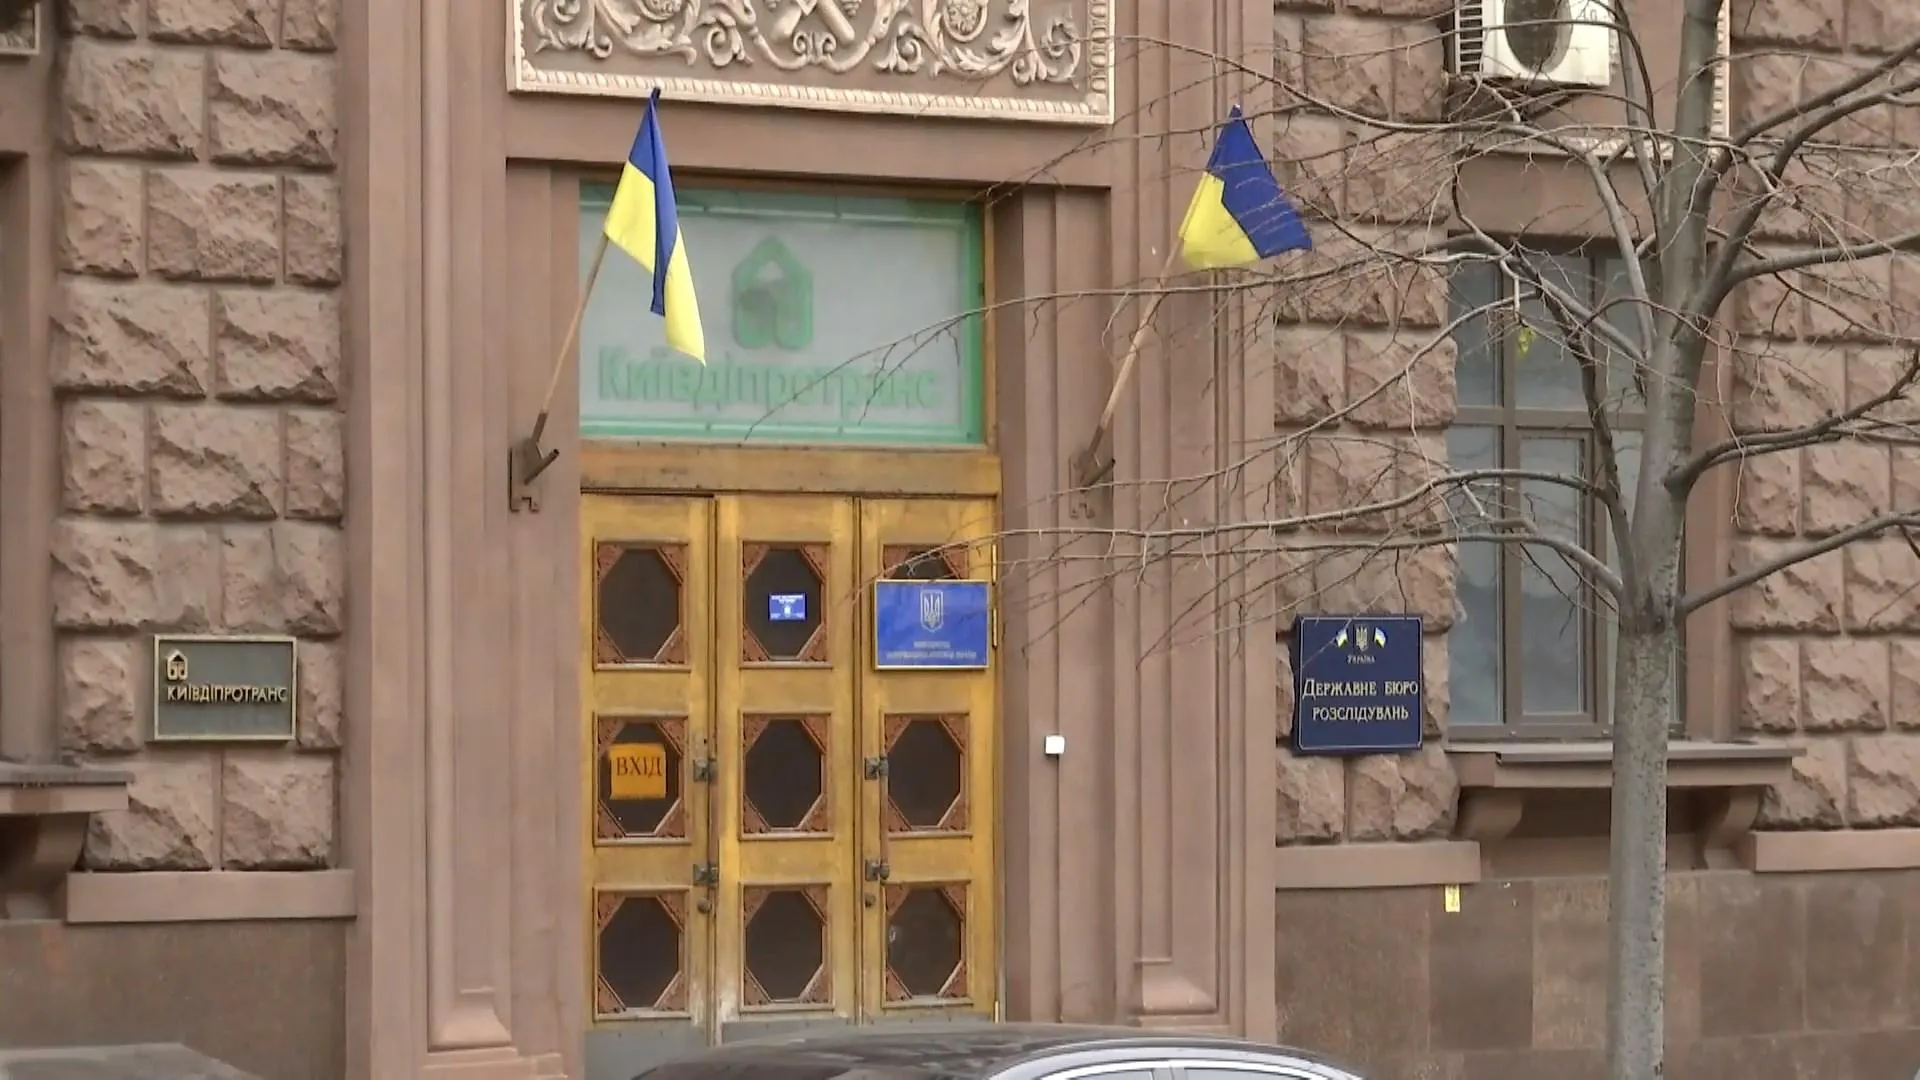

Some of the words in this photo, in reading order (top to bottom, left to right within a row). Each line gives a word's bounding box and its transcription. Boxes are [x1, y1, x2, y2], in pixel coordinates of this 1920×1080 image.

[598, 345, 941, 412] Київдіпротранс
[166, 683, 288, 703] КИЇВДІПРОТРАНС
[1384, 680, 1419, 697] БЮРО
[1312, 705, 1409, 724] РОЗСЛІДУВАНЬ
[616, 756, 663, 779] ВХІД
